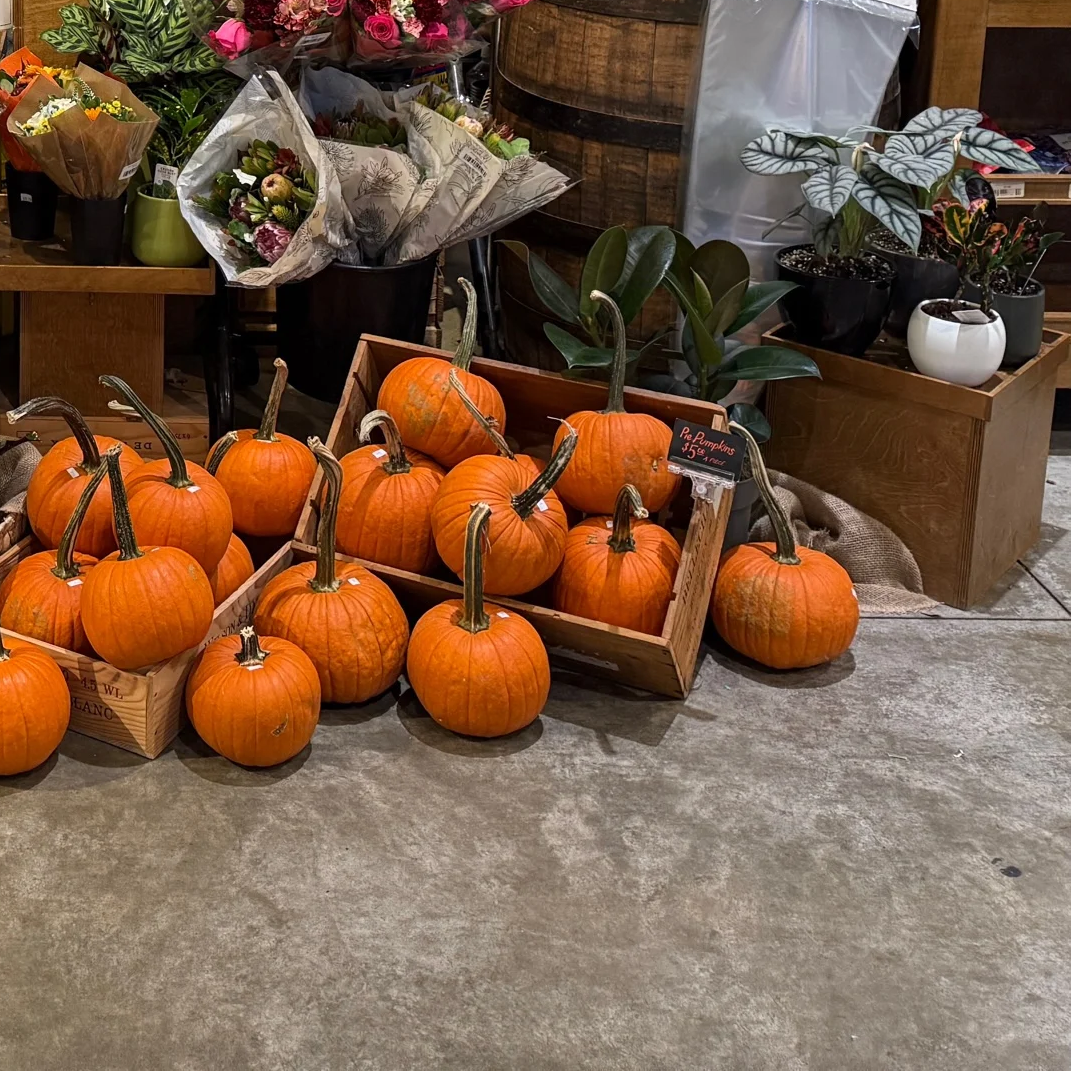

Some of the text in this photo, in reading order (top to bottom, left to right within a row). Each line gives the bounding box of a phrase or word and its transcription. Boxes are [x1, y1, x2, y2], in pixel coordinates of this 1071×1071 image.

[679, 426, 736, 456] Pie Pumpkins
[81, 677, 123, 700] 4.5 WL
